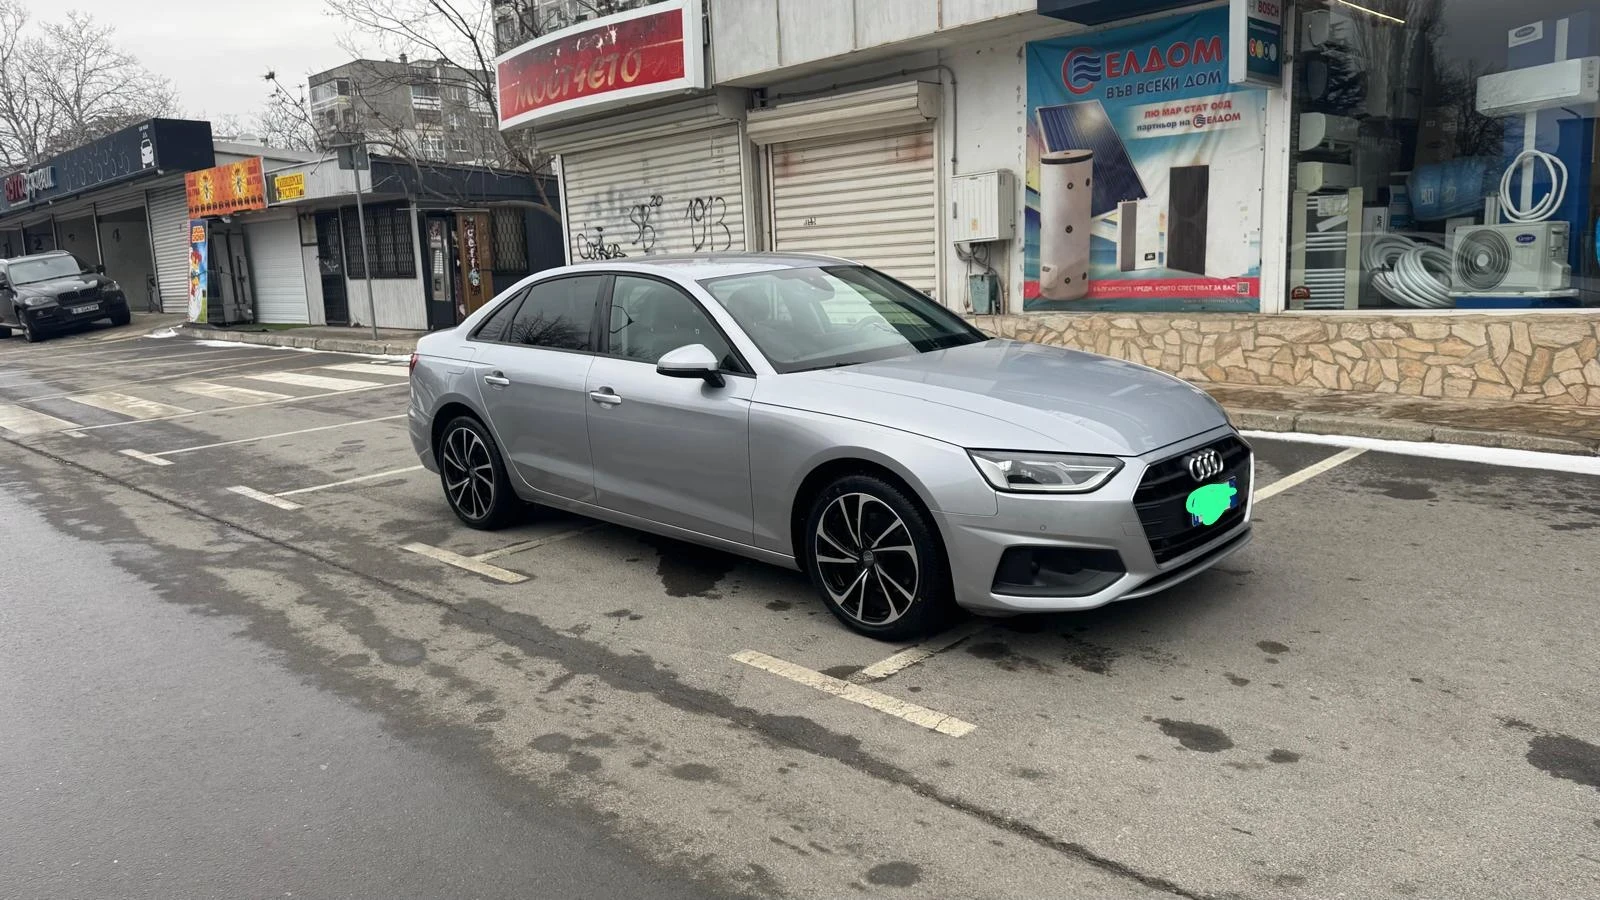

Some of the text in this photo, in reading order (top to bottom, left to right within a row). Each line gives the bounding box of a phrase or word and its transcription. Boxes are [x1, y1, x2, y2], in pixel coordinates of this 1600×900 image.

[1258, 1, 1279, 17] BOSCH
[1106, 35, 1223, 78] ЕЛДОМ
[1106, 70, 1222, 99] ВЪВ ВСЕКИ ДОМ
[1162, 106, 1182, 117] МАР
[1184, 103, 1208, 114] СТАТ
[1211, 100, 1232, 111] ООД
[1137, 121, 1177, 132] партньор
[1207, 113, 1241, 123] ЕЛДОМ
